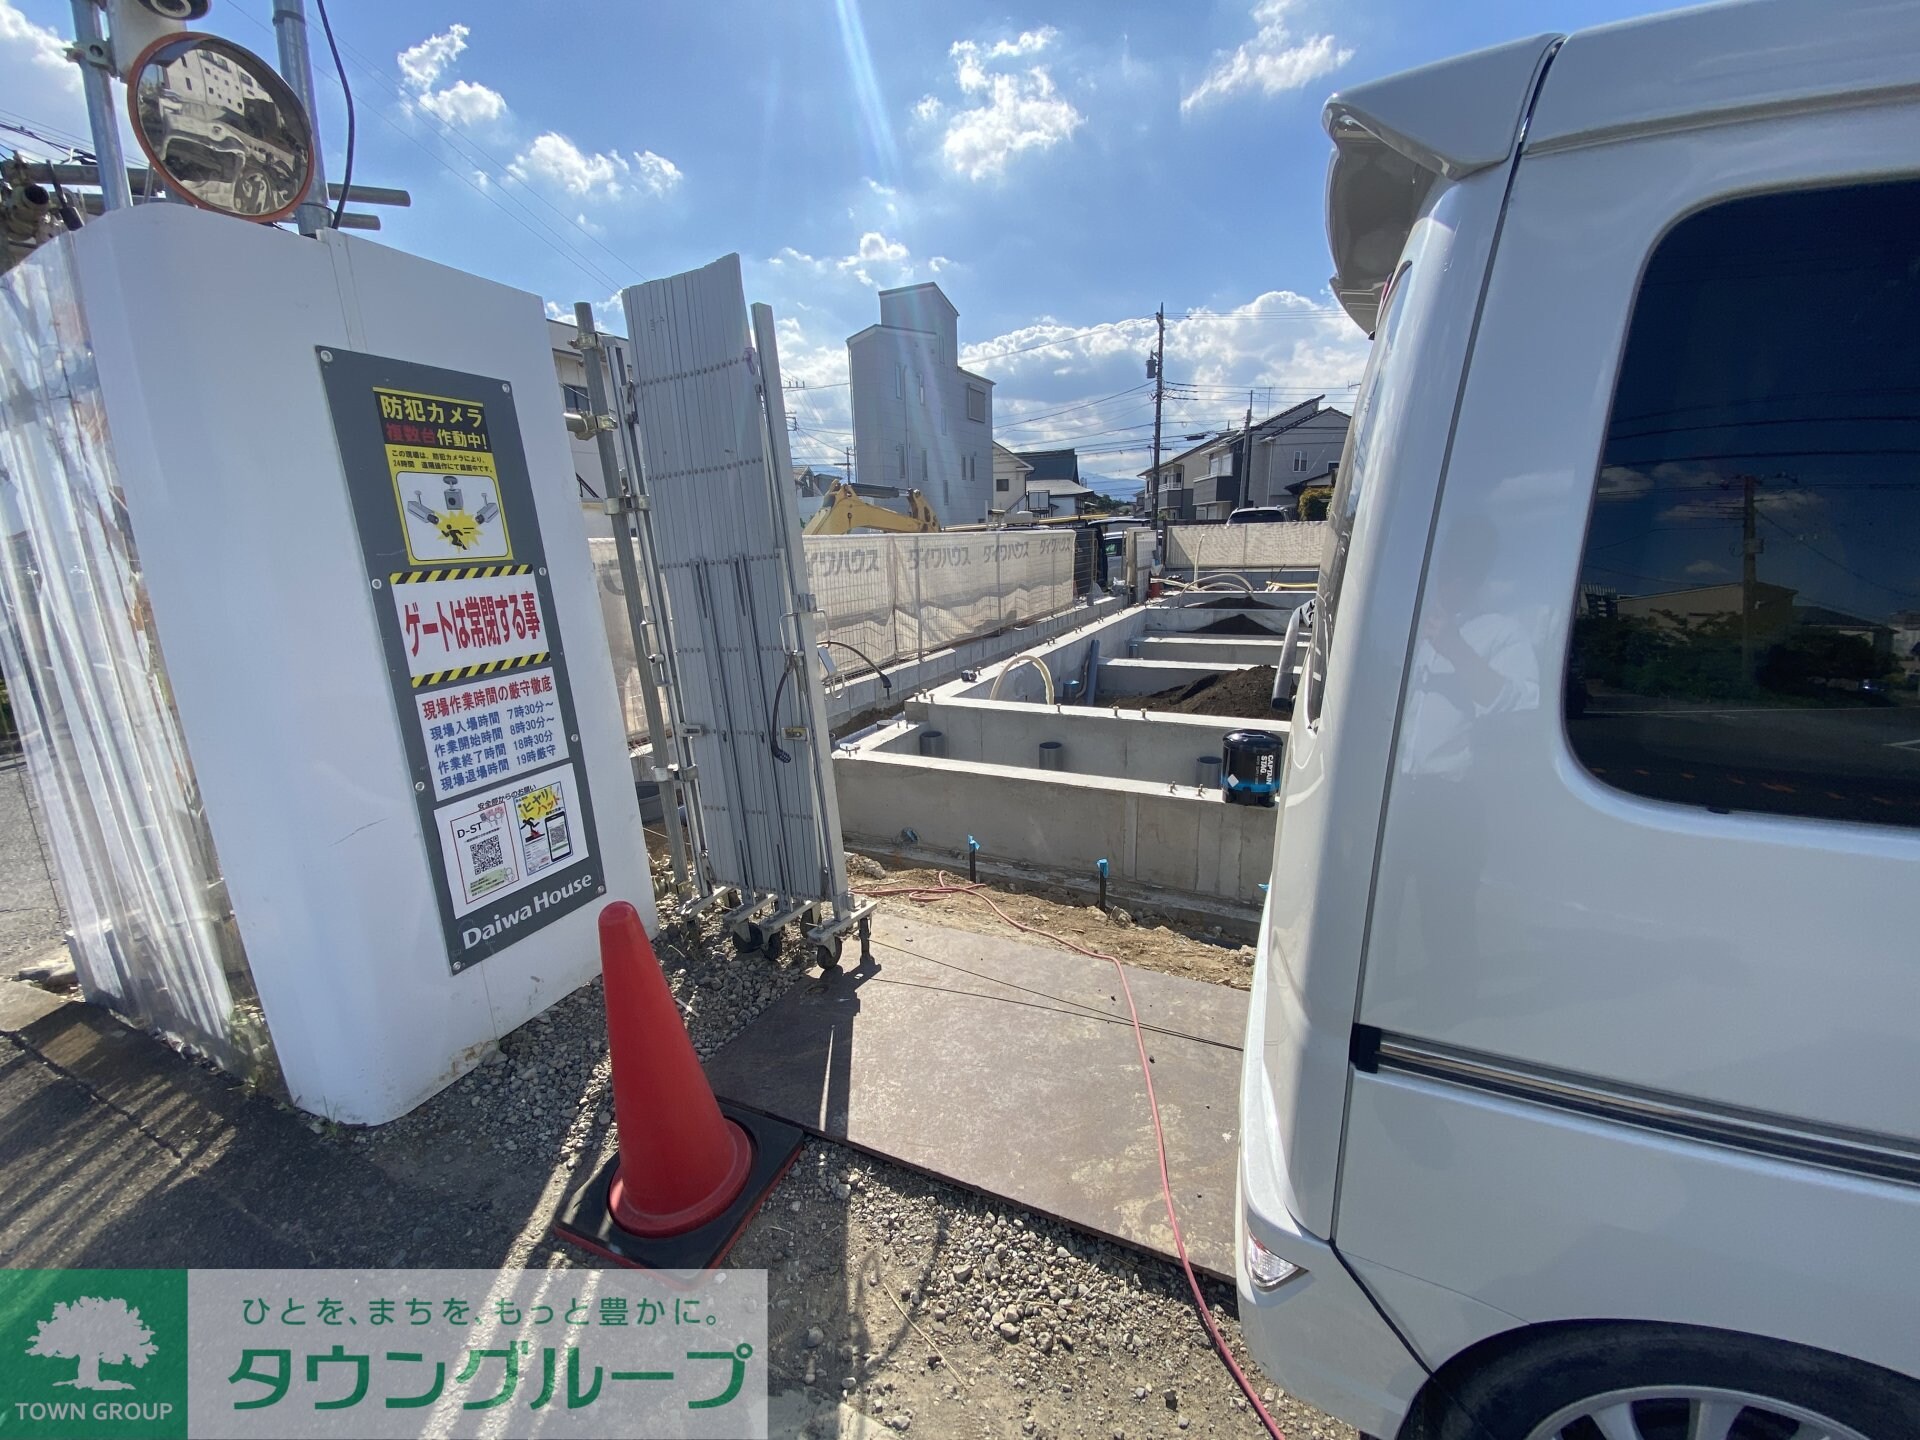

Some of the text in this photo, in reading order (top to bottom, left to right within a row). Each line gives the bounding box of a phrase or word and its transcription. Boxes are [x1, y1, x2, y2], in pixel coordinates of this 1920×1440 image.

[380, 395, 482, 428] 防犯カメラ
[404, 590, 541, 657] ゲートは常閉する事
[422, 674, 553, 720] 現場作業時間の厳守徹底
[429, 711, 501, 741] 現場入場時間
[434, 726, 504, 758] 作業開始時間
[438, 729, 553, 775] 作業終了時間 18時30分
[440, 744, 556, 791] 現場退場時間 19時厳守
[1266, 754, 1274, 785] CAPTAIN
[523, 788, 549, 813] ヒヤリ
[457, 821, 483, 839] D-ST
[462, 904, 533, 950] Daiwa
[533, 874, 592, 913] House
